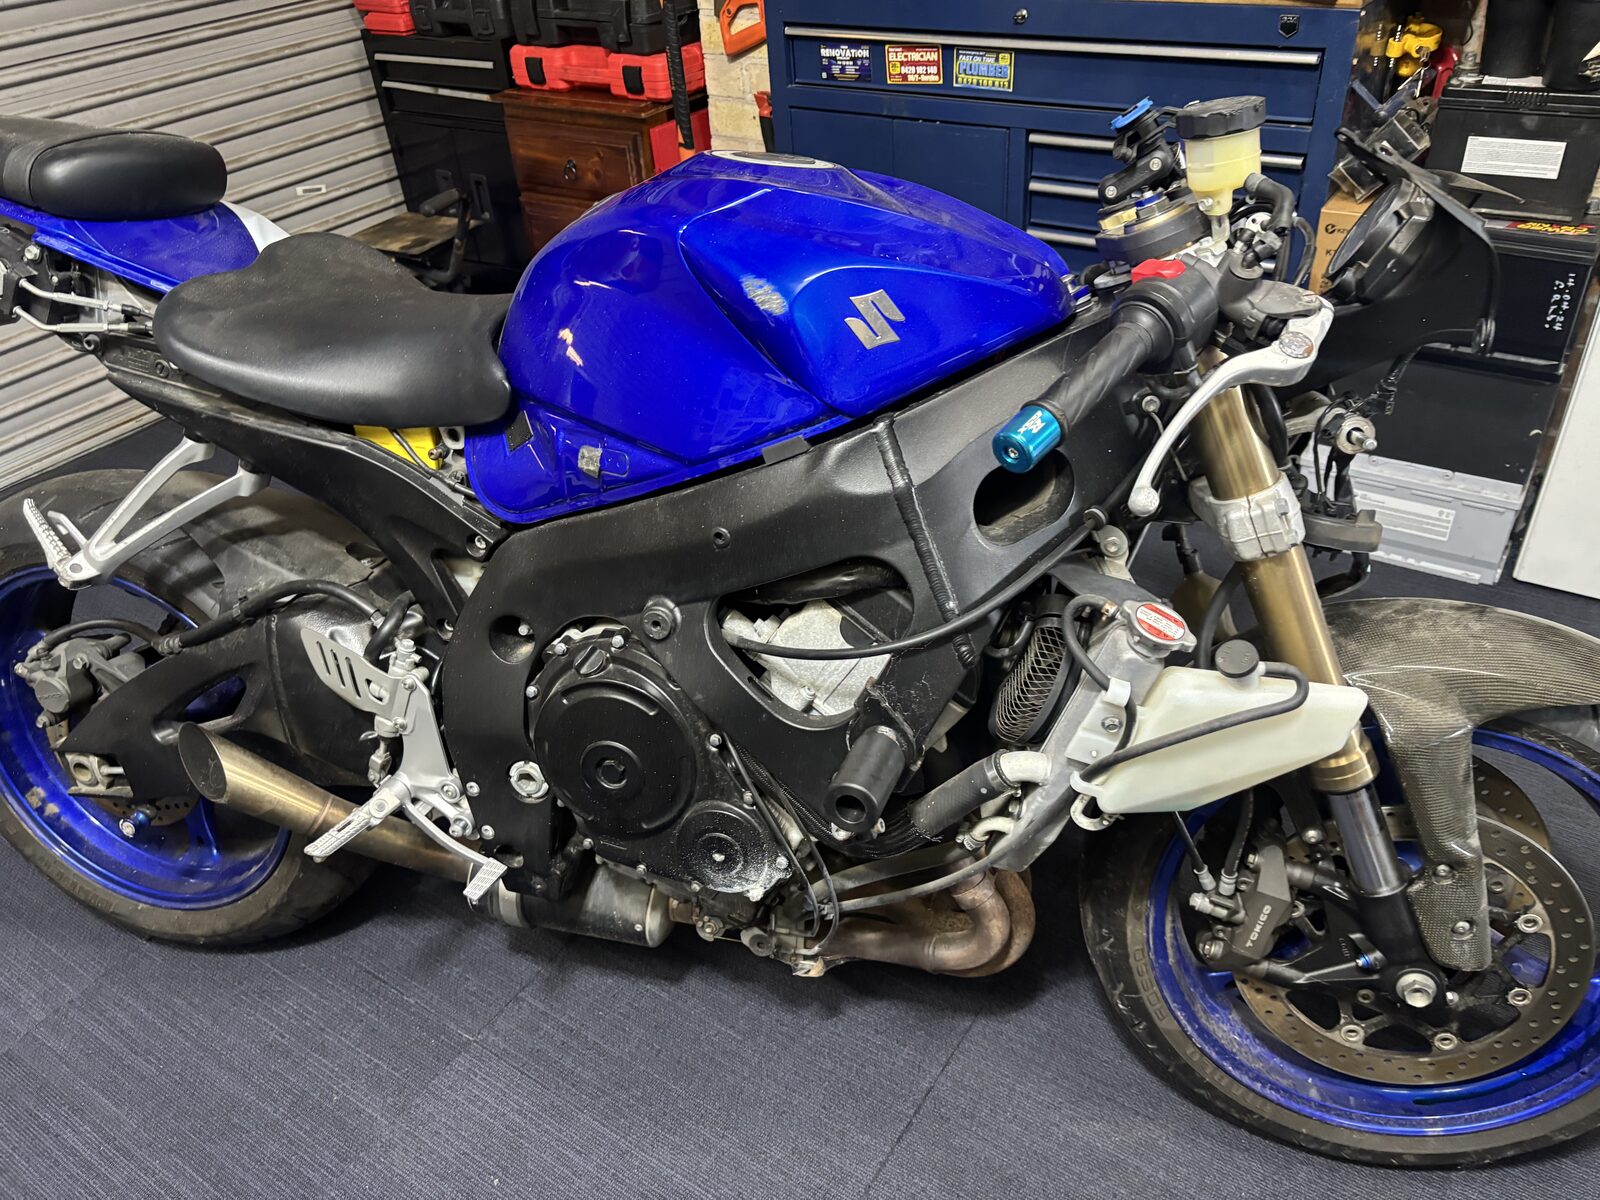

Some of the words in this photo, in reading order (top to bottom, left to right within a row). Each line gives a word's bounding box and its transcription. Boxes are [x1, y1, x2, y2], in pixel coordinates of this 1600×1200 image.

[820, 48, 870, 58] RENOVATION
[888, 51, 938, 62] ELECTRICIAN
[958, 54, 973, 62] FAST
[959, 61, 1009, 78] PLUMBER
[1245, 904, 1273, 948] TOKICO
[1133, 948, 1167, 1022] ROSSO
